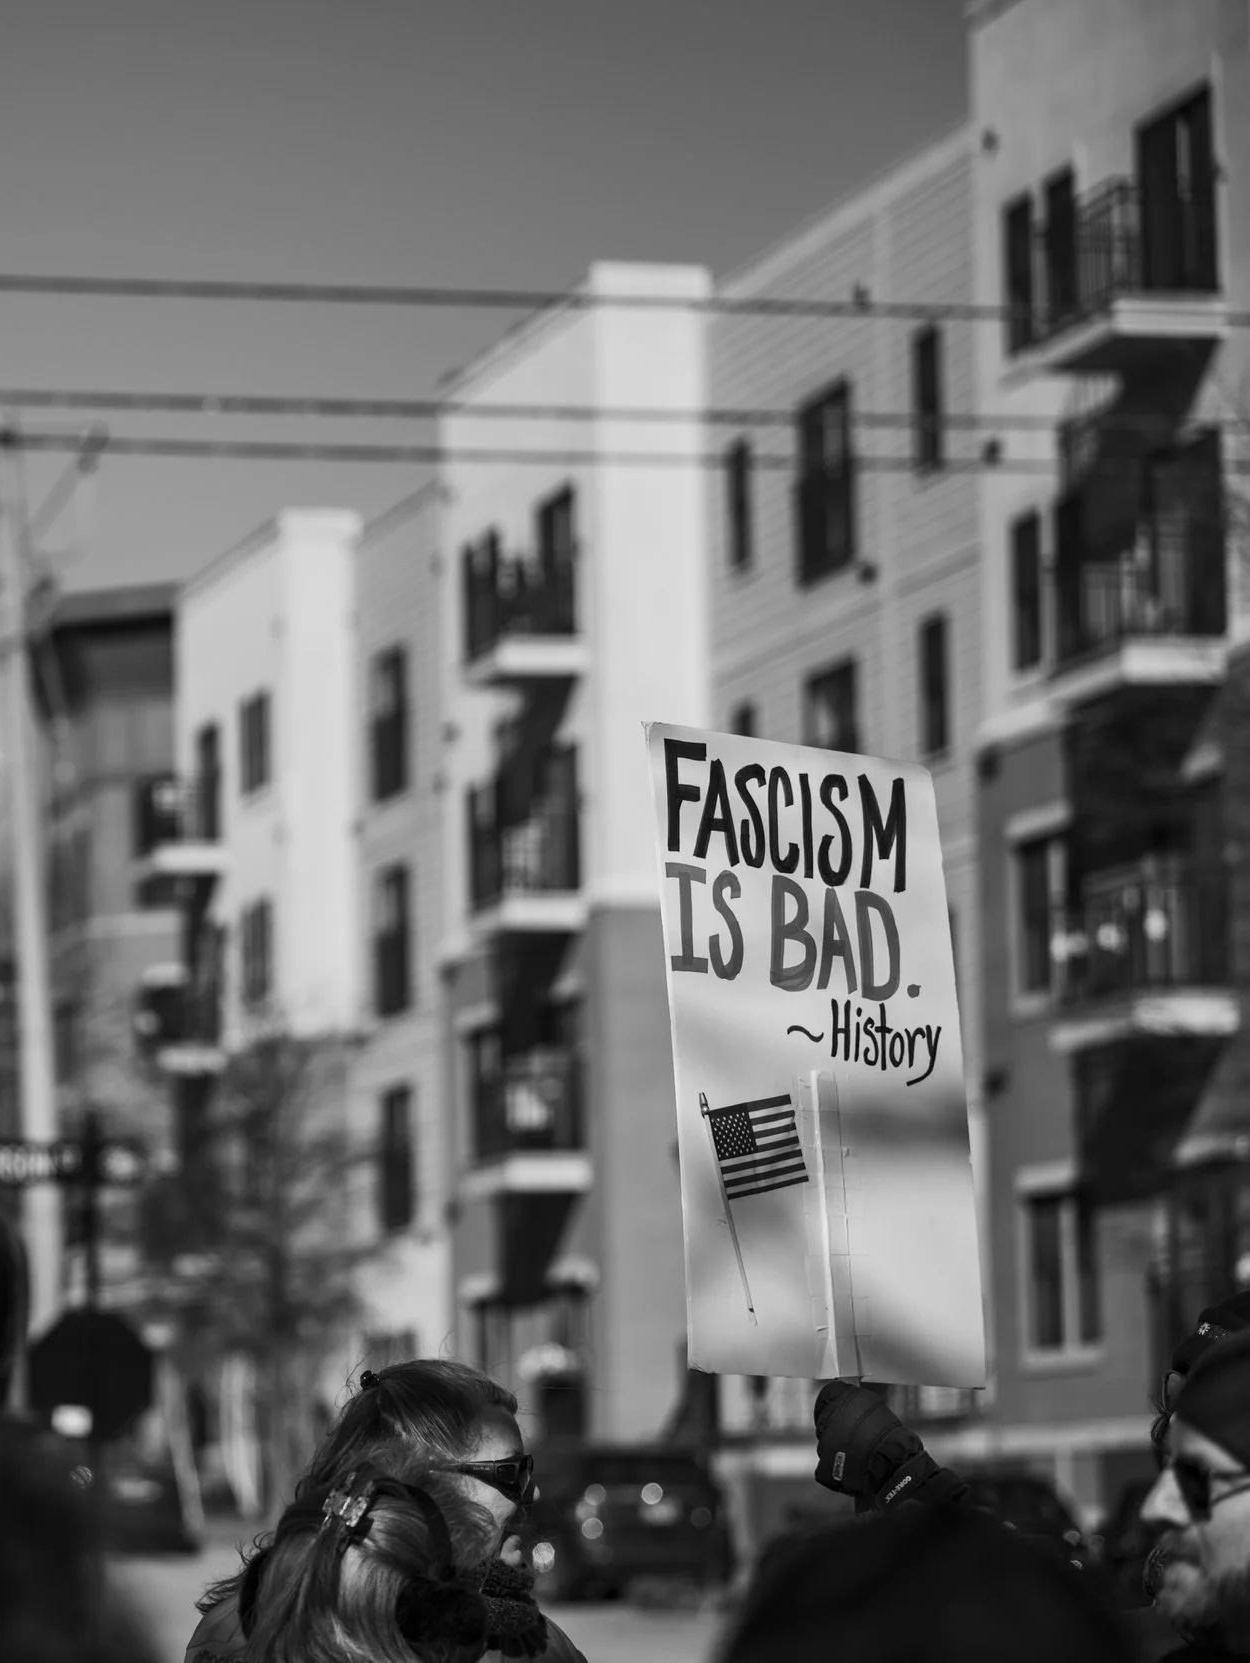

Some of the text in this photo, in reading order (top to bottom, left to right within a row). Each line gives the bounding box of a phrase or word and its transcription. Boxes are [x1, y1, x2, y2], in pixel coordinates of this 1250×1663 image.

[664, 738, 906, 892] FASCISM
[665, 862, 921, 1001] IS BAD.
[885, 1476, 911, 1503] GORE-TEX
